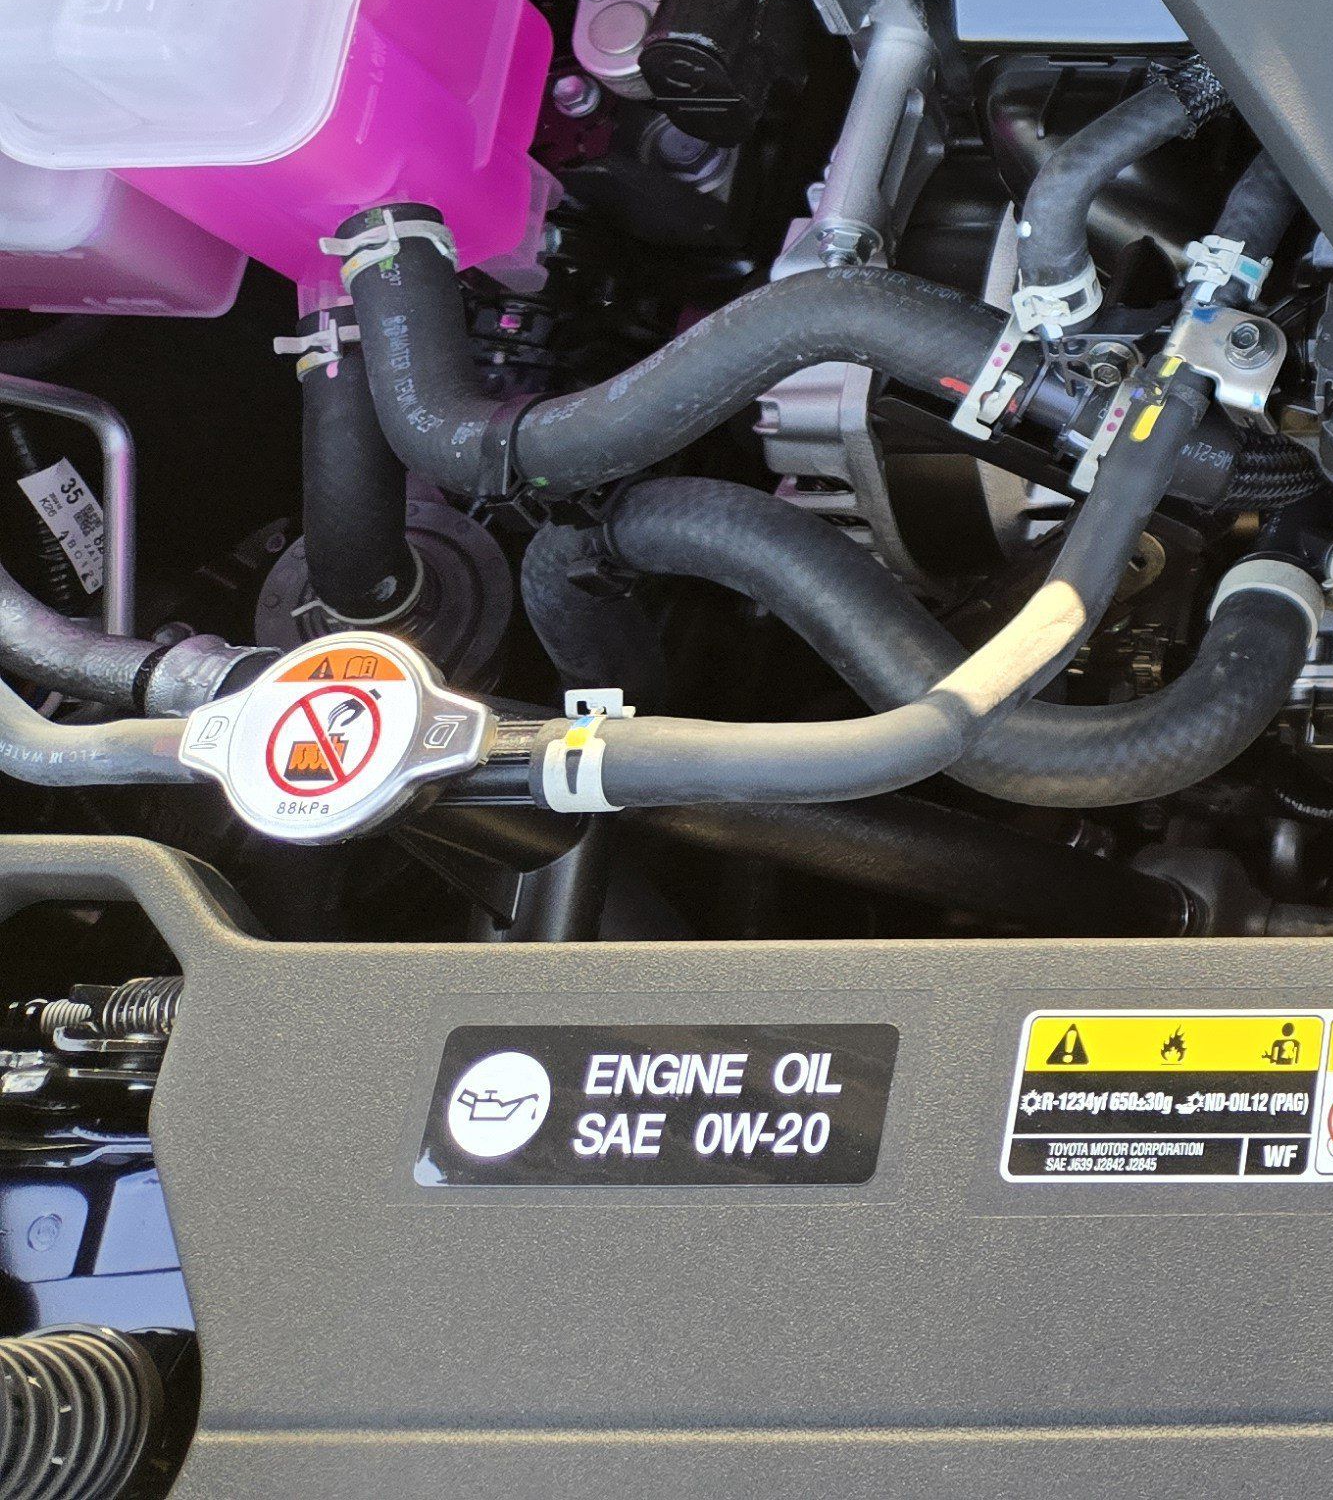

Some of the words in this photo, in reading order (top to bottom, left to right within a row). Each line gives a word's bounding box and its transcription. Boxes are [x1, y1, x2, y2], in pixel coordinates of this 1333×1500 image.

[58, 477, 85, 506] 35
[276, 801, 329, 815] 88kPa
[585, 1053, 748, 1095] ENGINE
[773, 1052, 842, 1094] OIL
[1041, 1091, 1108, 1115] R-1234yf
[1109, 1091, 1173, 1115] 650±30g
[1270, 1092, 1309, 1116] (PAG)
[573, 1112, 667, 1155] SAE
[695, 1112, 831, 1155] 0W-20
[1048, 1142, 1089, 1156] TOYOTA
[1090, 1142, 1129, 1156] MOTOR
[1130, 1142, 1205, 1156] CORPORATION
[1263, 1145, 1298, 1167] WF
[1045, 1158, 1067, 1171] SAE
[1067, 1158, 1093, 1171] J639
[1093, 1158, 1125, 1171] J2842
[1126, 1158, 1157, 1171] J2845
